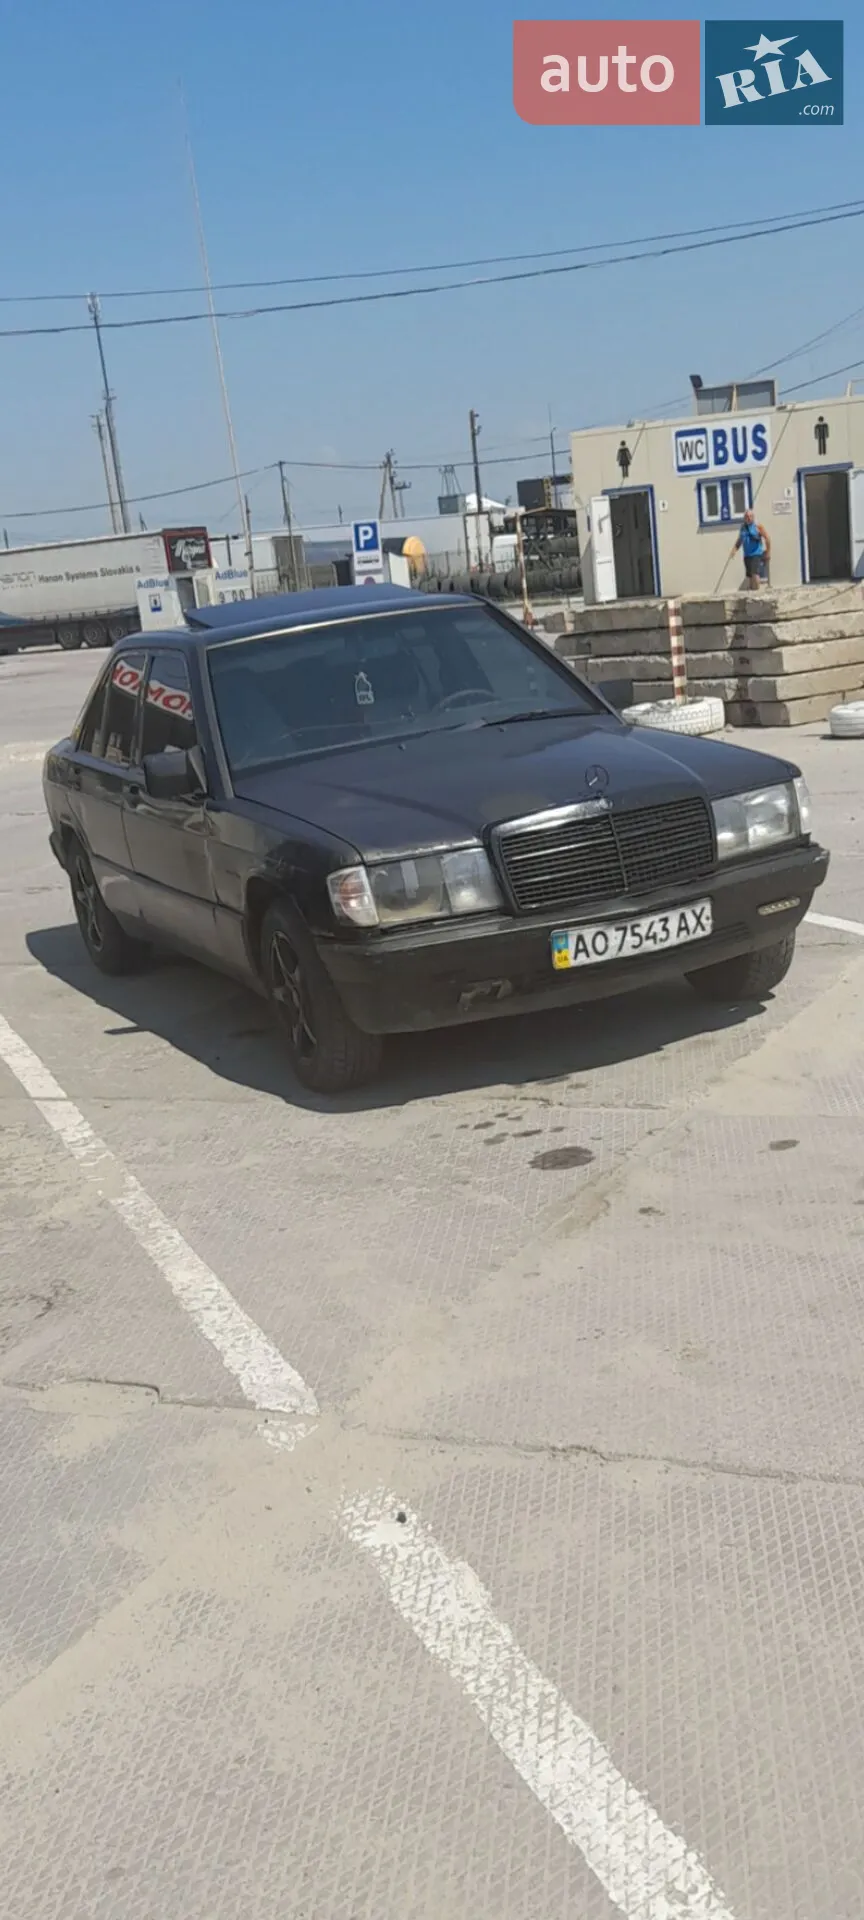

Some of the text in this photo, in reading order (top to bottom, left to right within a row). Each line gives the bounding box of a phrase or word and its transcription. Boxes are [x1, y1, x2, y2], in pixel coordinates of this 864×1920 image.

[680, 423, 768, 466] WC BUS
[358, 525, 373, 549] P
[64, 570, 98, 583] Systems
[100, 564, 134, 577] Slovakia
[137, 578, 169, 589] AdBlue
[216, 569, 248, 580] AdBlue
[574, 906, 706, 960] AO 7543 AX
